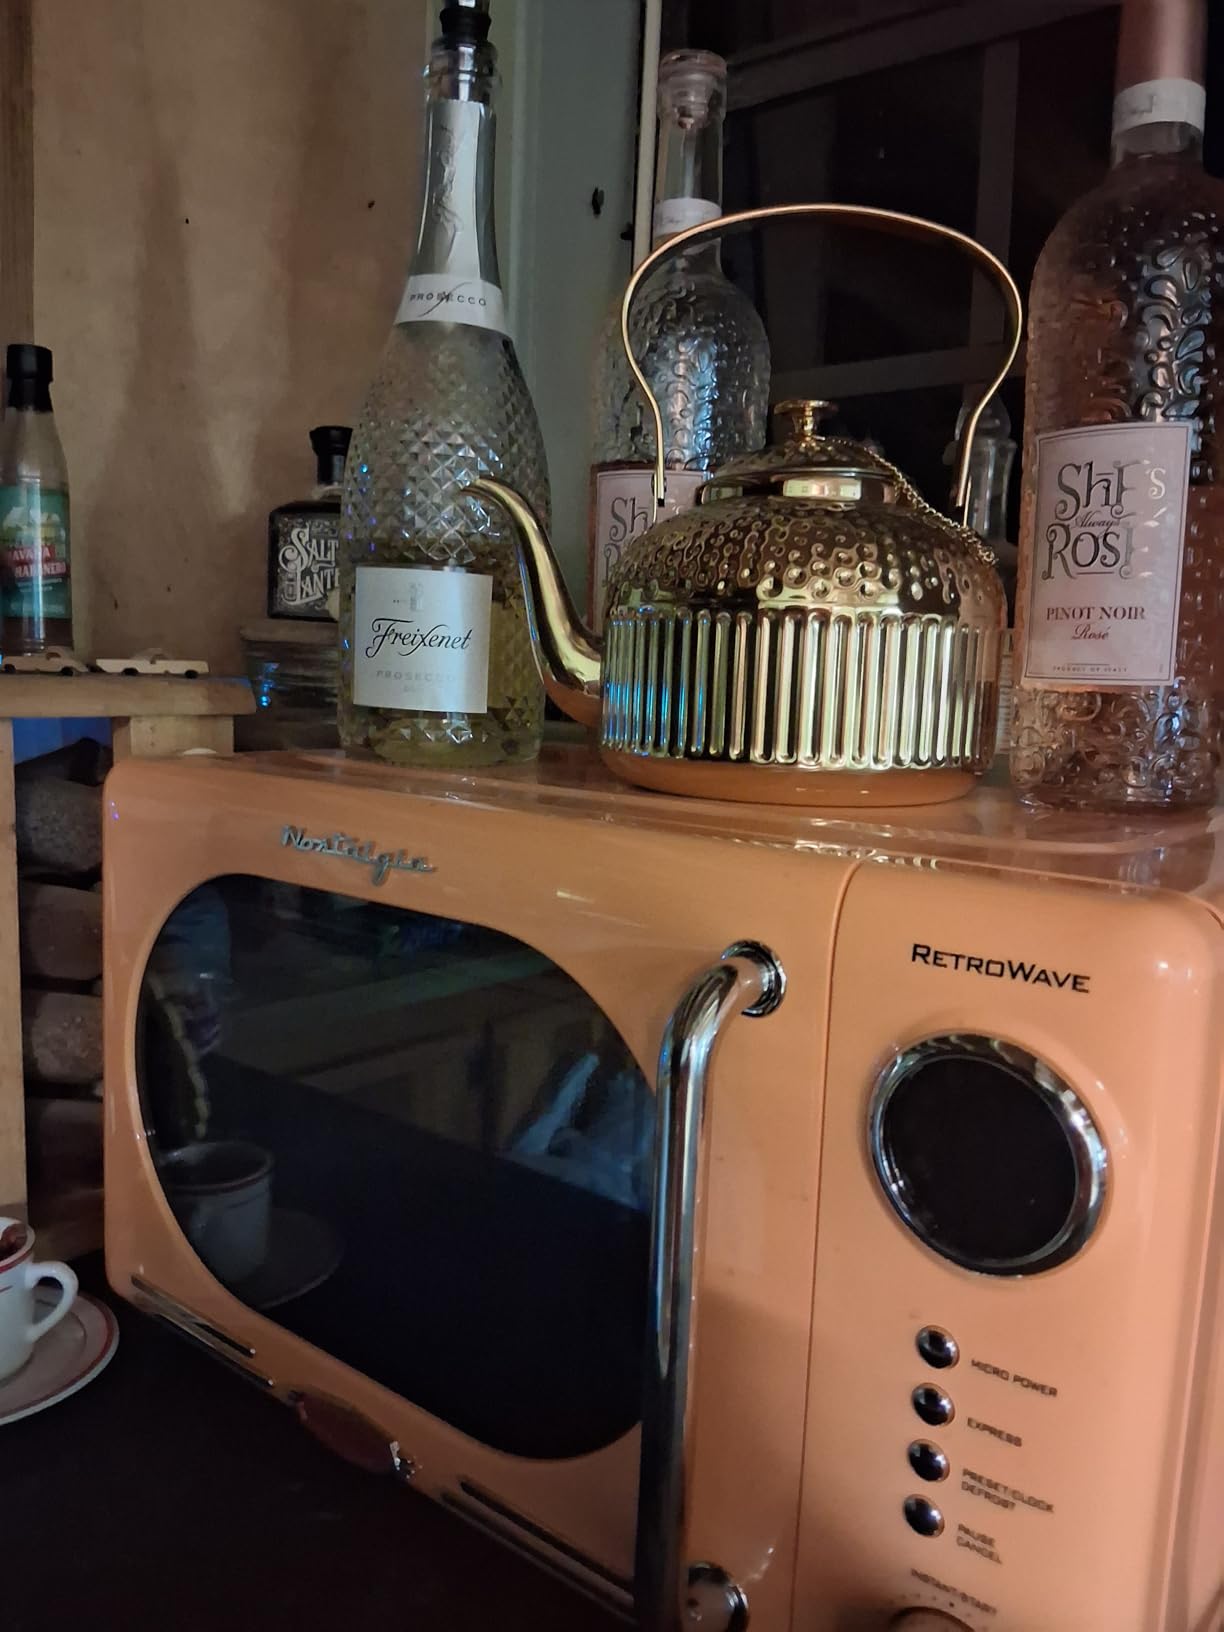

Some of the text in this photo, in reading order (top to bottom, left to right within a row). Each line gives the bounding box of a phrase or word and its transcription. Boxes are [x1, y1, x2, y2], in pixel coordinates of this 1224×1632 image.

[1046, 605, 1146, 621] PINOT NOIR
[366, 617, 474, 659] Freixenet
[1071, 623, 1112, 640] Rosé
[971, 1359, 1058, 1397] MICRO POWER
